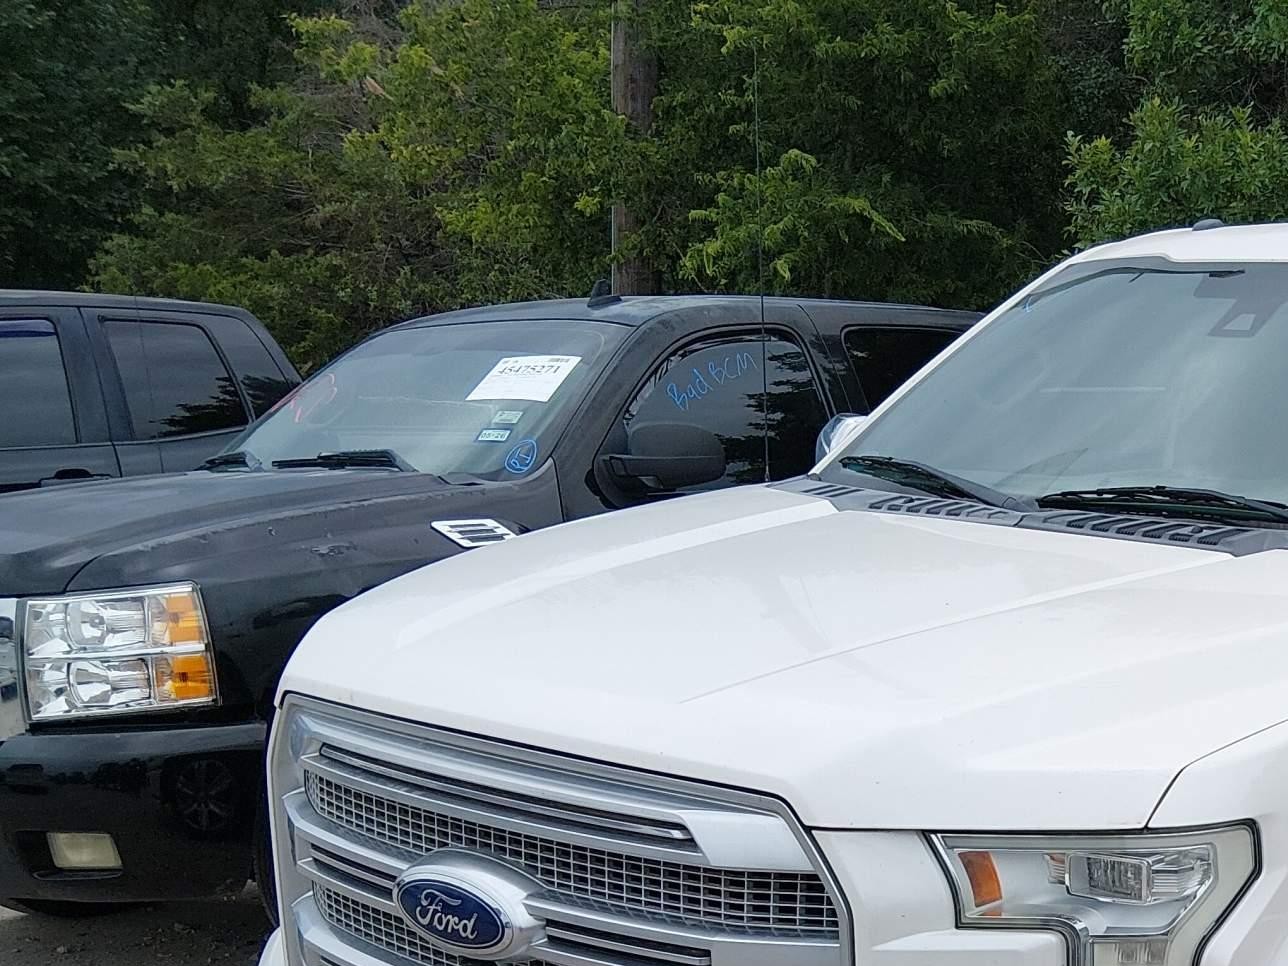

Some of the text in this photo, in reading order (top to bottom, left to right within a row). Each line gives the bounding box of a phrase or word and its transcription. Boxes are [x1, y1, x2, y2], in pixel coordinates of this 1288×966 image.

[667, 352, 757, 411] Bad BCM
[416, 888, 478, 940] Ford
